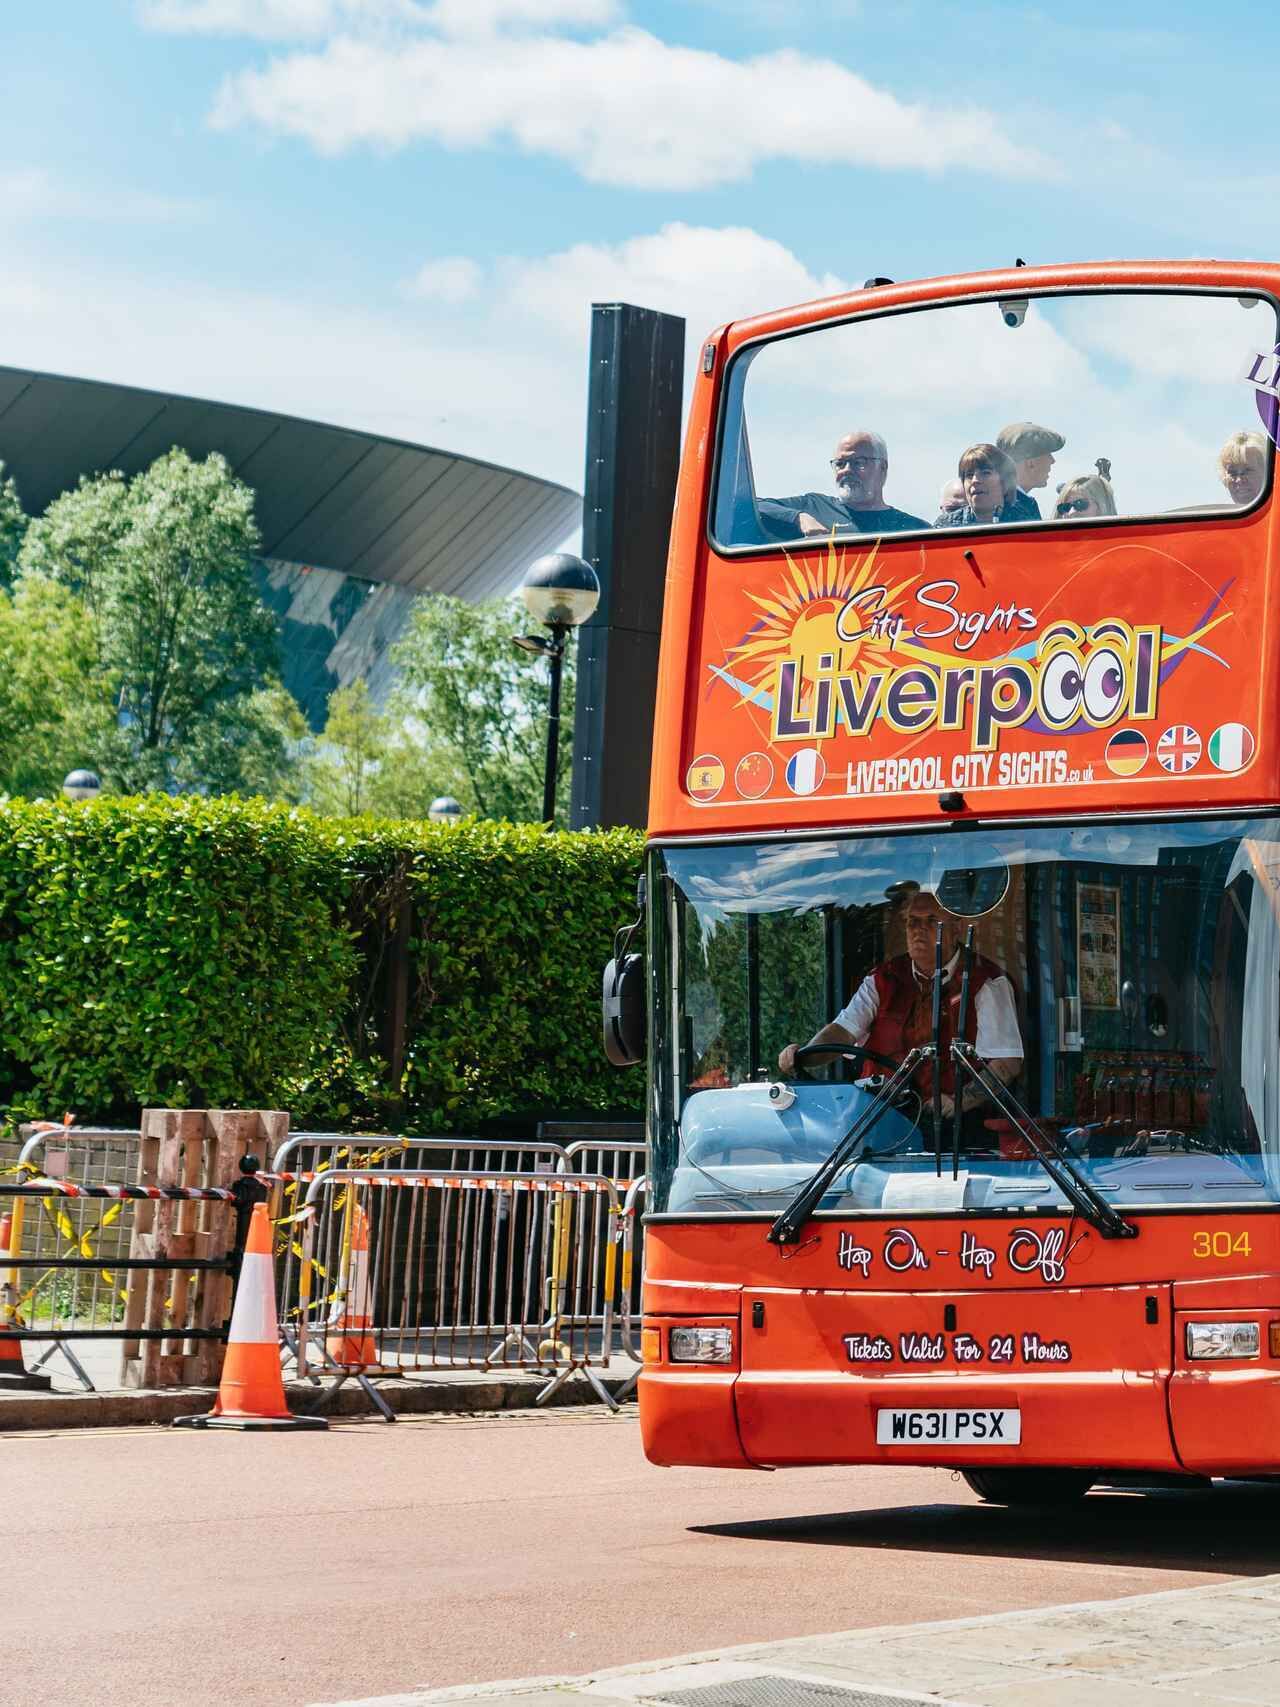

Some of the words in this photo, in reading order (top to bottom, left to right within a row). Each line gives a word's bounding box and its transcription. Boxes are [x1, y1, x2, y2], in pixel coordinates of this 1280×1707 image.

[836, 584, 904, 650] City
[913, 580, 1039, 650] Sights
[773, 618, 1162, 751] Liverpool
[847, 756, 945, 793] LIVERPOOL
[952, 754, 993, 786] CITY
[838, 1231, 873, 1277] Hop
[884, 1229, 929, 1270] On
[960, 1232, 996, 1278] Hop
[1009, 1229, 1065, 1282] Off
[1193, 1231, 1252, 1257] 304
[844, 1336, 893, 1361] Tickets
[900, 1335, 945, 1361] Valid
[954, 1336, 982, 1361] For
[990, 1338, 1013, 1361] 24
[1023, 1335, 1070, 1361] Hours
[892, 1412, 948, 1439] W631
[955, 1411, 1004, 1438] PSX
